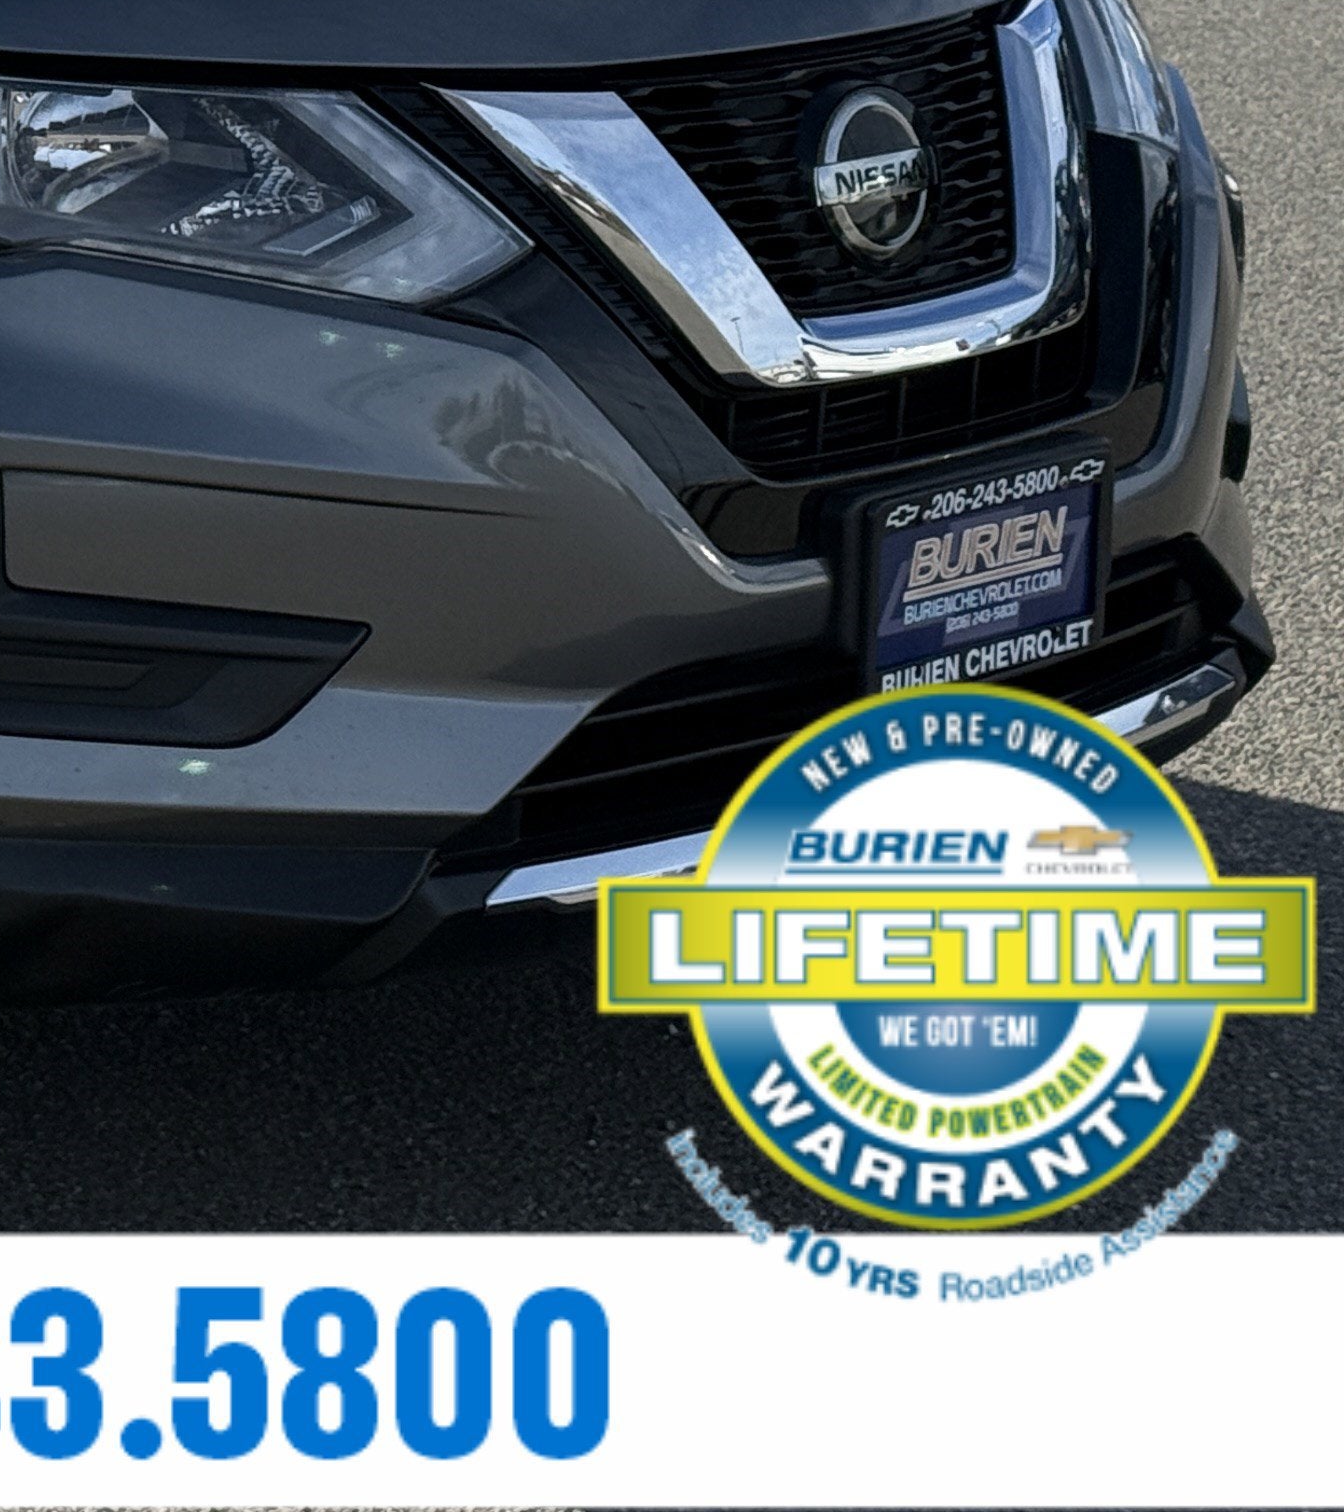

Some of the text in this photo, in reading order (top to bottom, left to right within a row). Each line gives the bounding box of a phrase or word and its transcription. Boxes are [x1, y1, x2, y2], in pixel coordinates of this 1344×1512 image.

[833, 153, 928, 196] NISSAN
[930, 465, 1059, 520] 206-243-5800
[907, 505, 1068, 588] BURIEN
